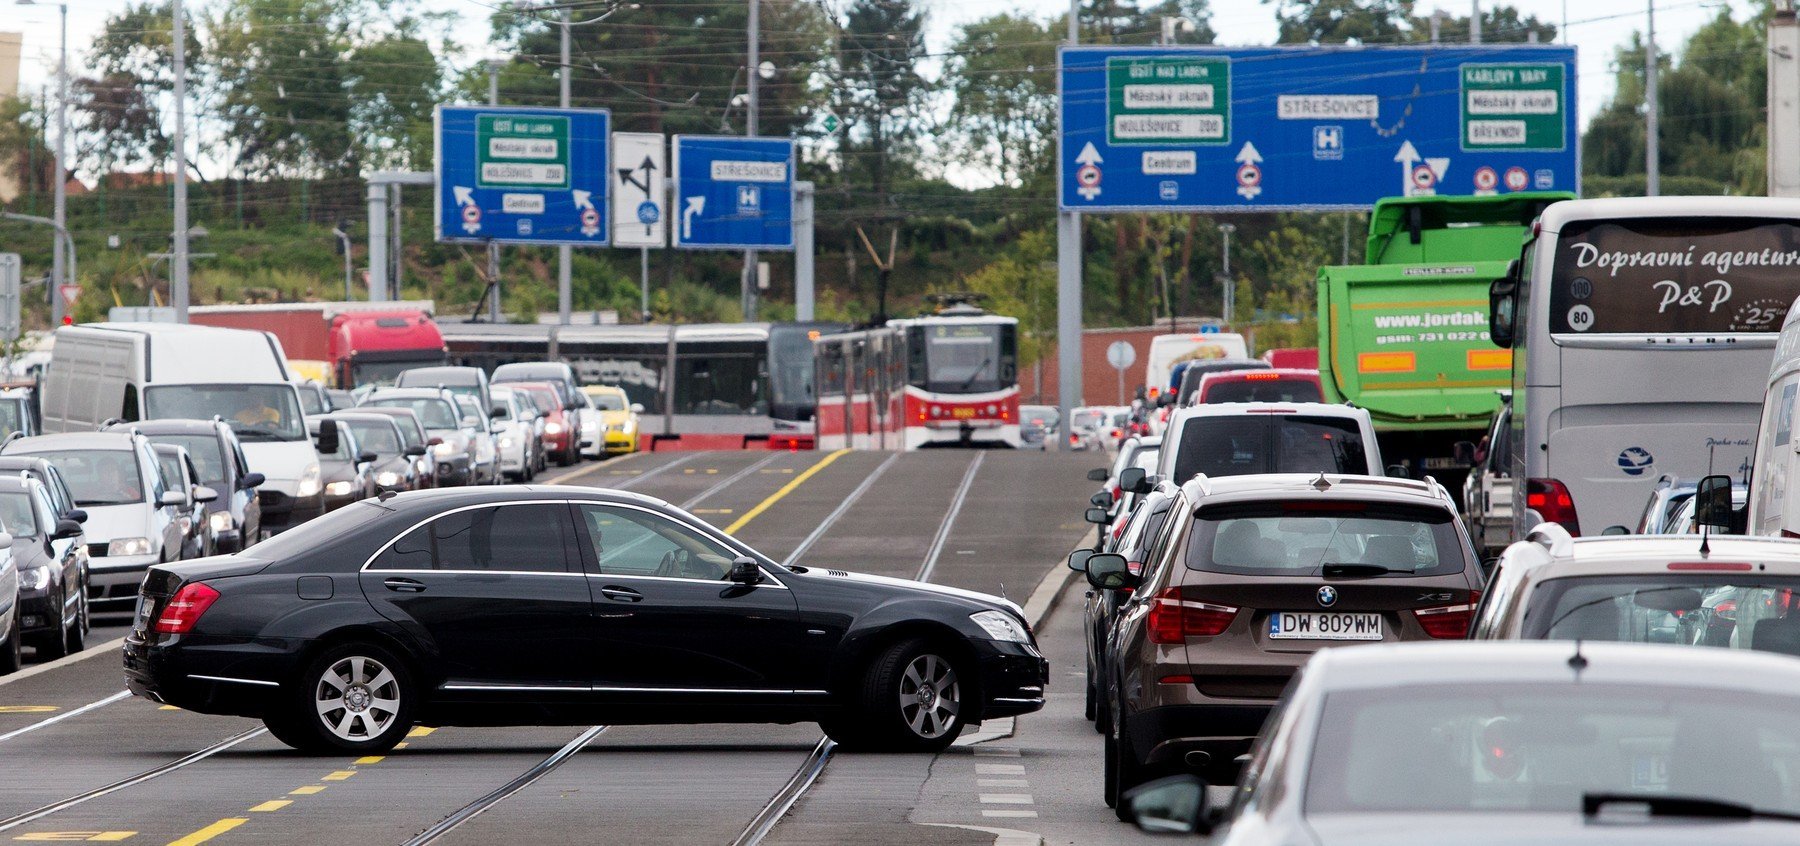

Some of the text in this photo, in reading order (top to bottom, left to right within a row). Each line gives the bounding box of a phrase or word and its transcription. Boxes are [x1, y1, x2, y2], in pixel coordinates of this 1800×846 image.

[1466, 70, 1547, 82] KARLOVY VARY
[1283, 97, 1373, 115] STŘEŠOVICE
[1119, 118, 1181, 132] HOLEŠOVICE
[716, 161, 782, 177] STŘEŠOVICE
[1147, 156, 1191, 169] Centrum
[1570, 242, 1696, 277] Dopravní
[1573, 282, 1589, 295] 100
[1652, 279, 1732, 313] P&P
[1573, 312, 1588, 324] 80
[1745, 307, 1777, 325] 25
[1376, 334, 1415, 345] gsm:
[1447, 331, 1477, 341] 022
[1417, 593, 1452, 601] X3
[1283, 614, 1311, 632] DW
[1319, 615, 1379, 633] 809WM
